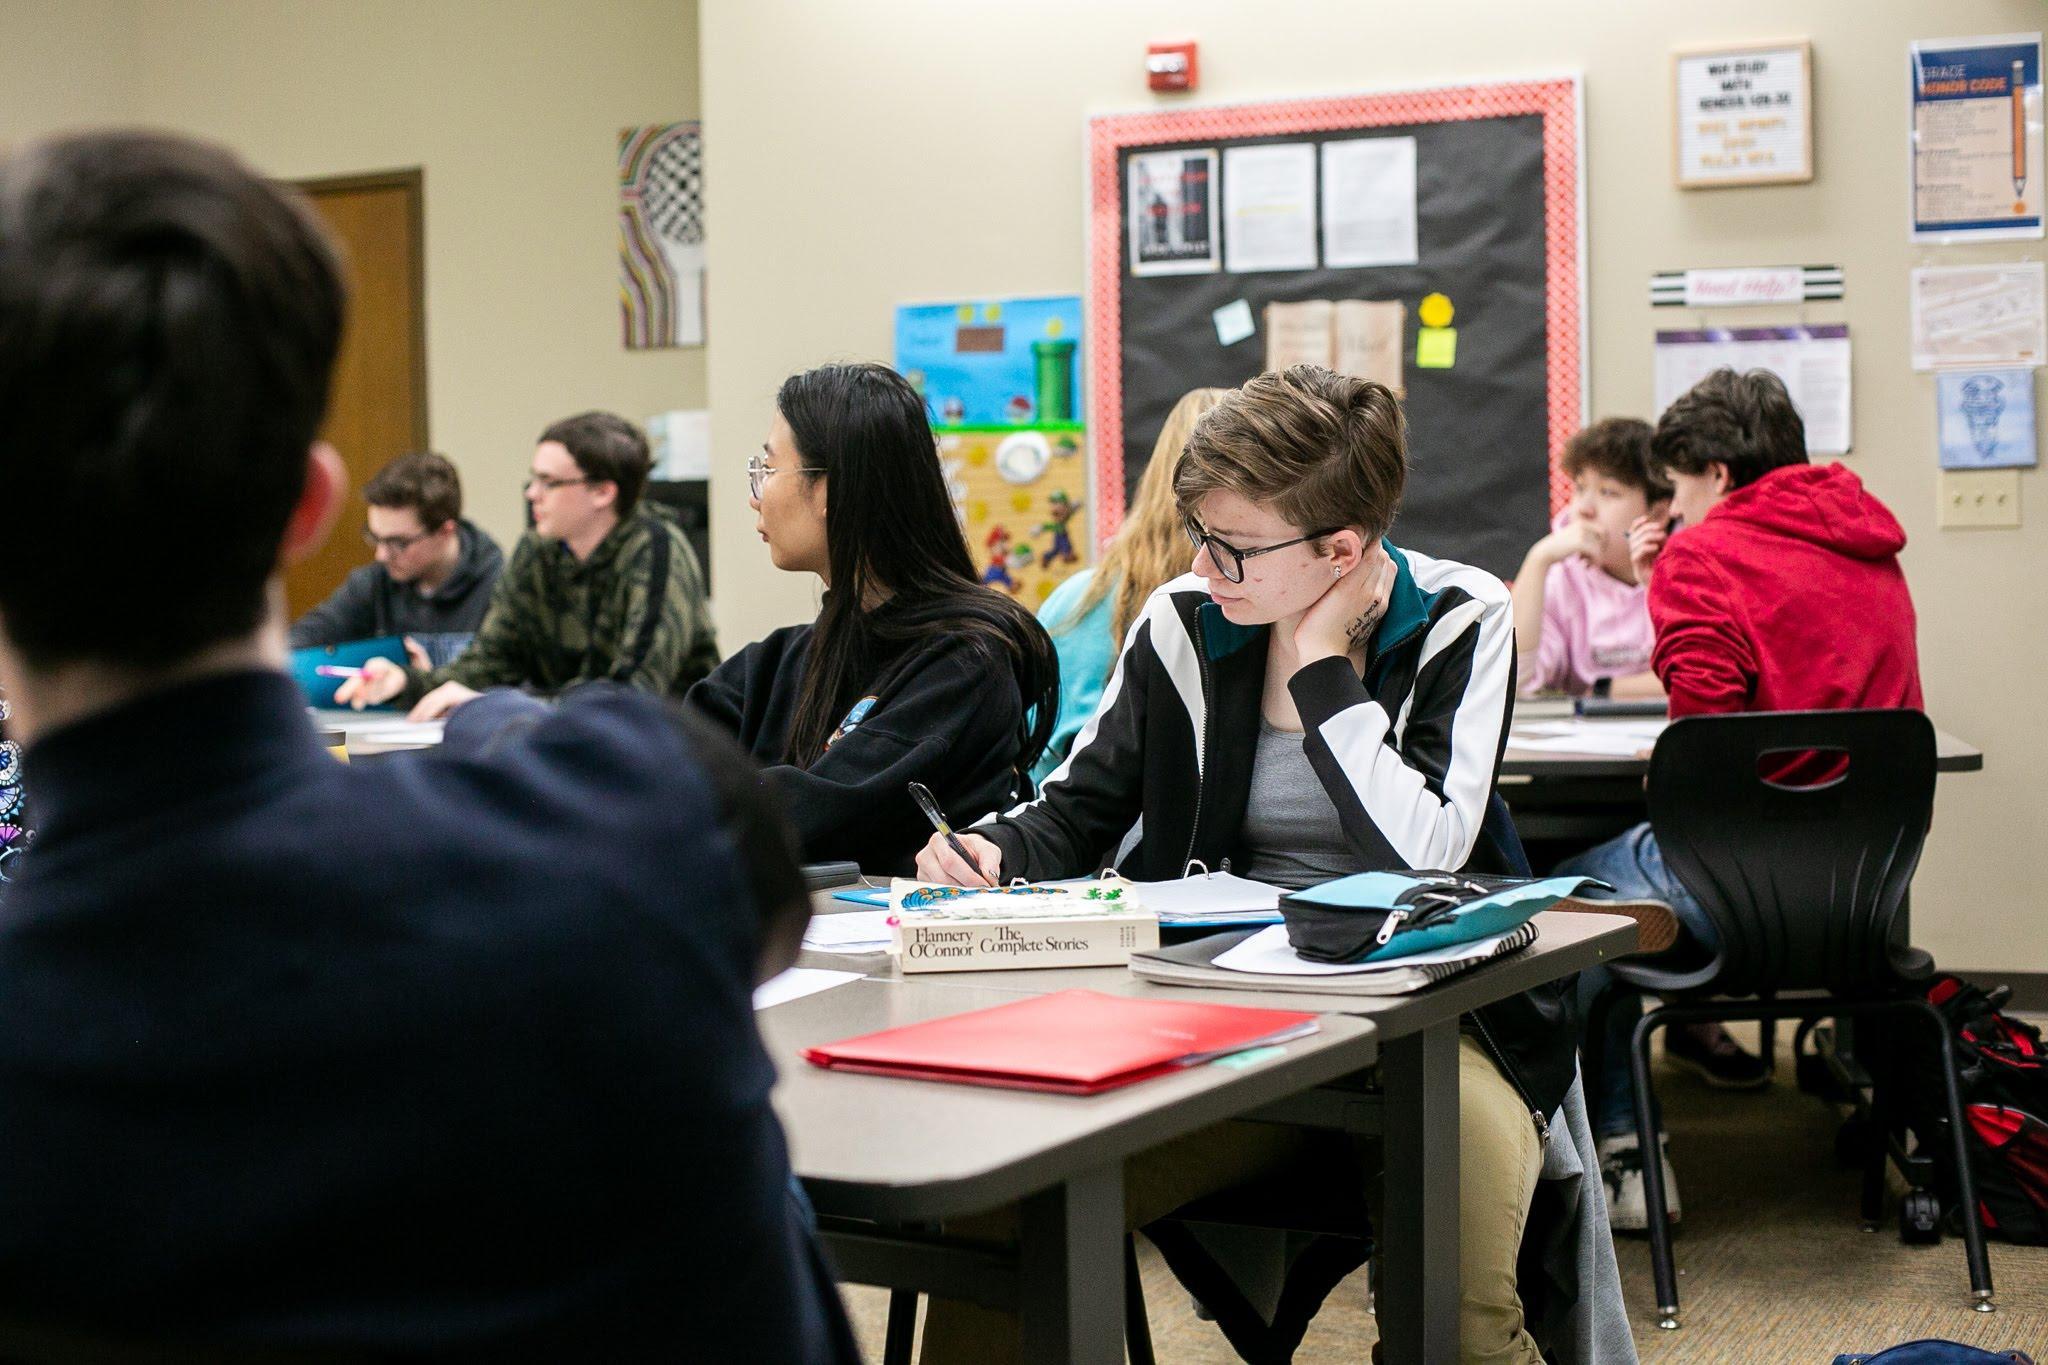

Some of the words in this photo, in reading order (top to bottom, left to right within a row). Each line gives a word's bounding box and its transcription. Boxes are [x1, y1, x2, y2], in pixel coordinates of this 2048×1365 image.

[1970, 77, 2007, 92] CODE
[916, 927, 973, 945] Flannery
[995, 926, 1021, 940] The
[909, 943, 973, 958] O'Connor
[980, 938, 1043, 955] Complete
[1045, 936, 1088, 951] Stories
